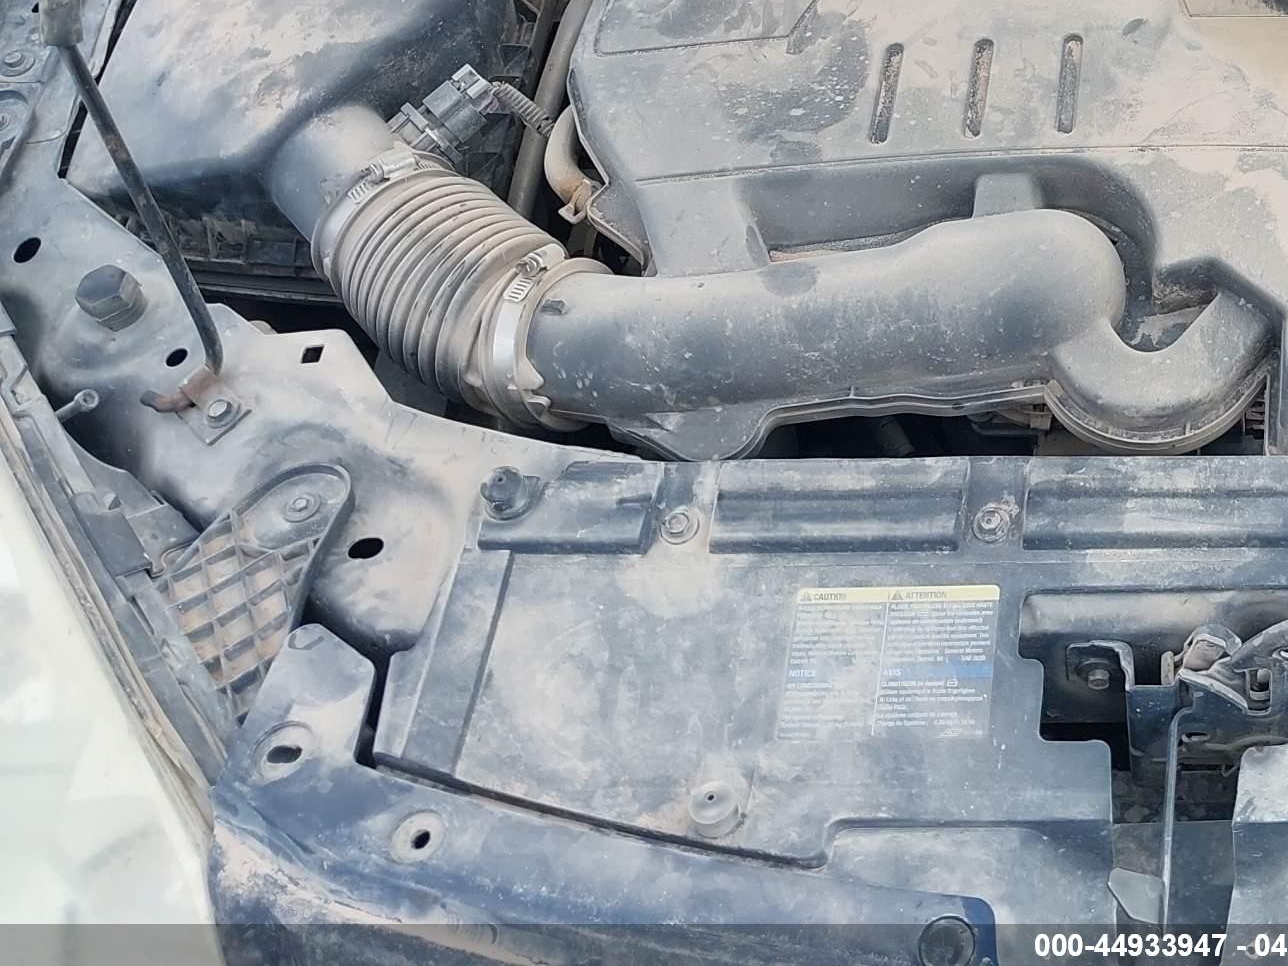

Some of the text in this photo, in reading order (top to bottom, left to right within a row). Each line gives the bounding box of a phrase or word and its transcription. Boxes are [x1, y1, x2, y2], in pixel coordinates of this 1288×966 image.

[813, 593, 848, 601] CAUTION
[904, 591, 948, 600] ATTENTION
[884, 668, 903, 676] AVIS
